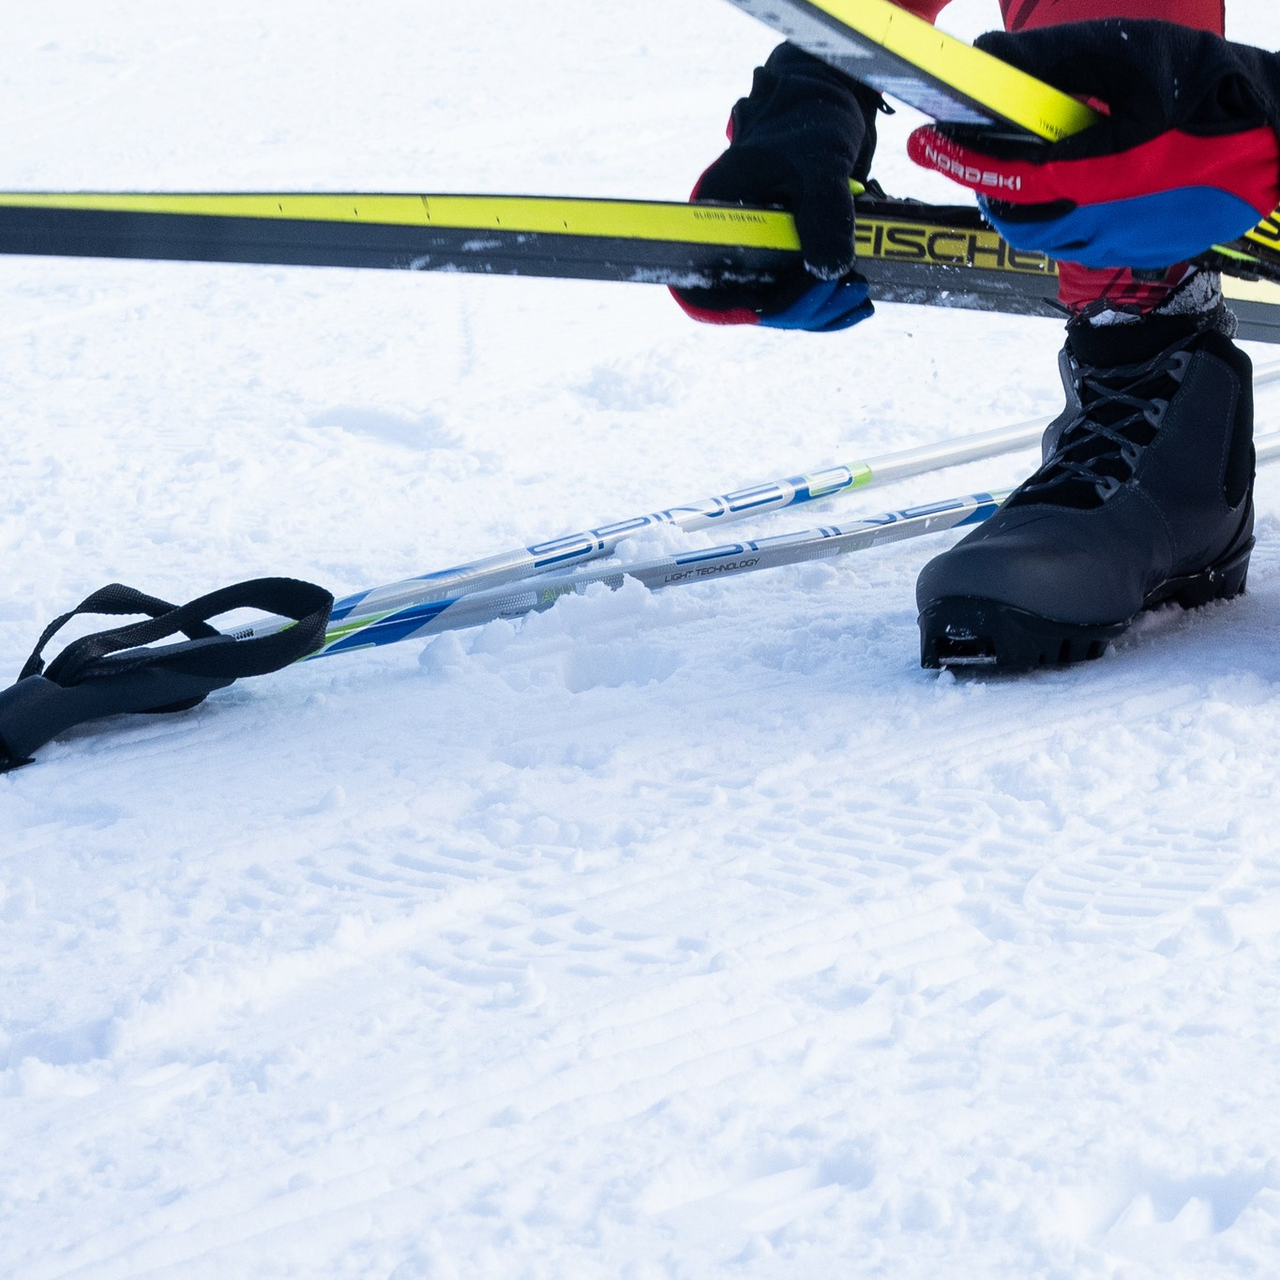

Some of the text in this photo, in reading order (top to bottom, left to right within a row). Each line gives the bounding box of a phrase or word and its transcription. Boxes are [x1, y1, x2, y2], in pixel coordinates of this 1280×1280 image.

[925, 143, 1021, 191] NORDSKI
[855, 223, 1058, 273] FISCHE
[664, 557, 760, 584] LIGHT TECHNOLOGY
